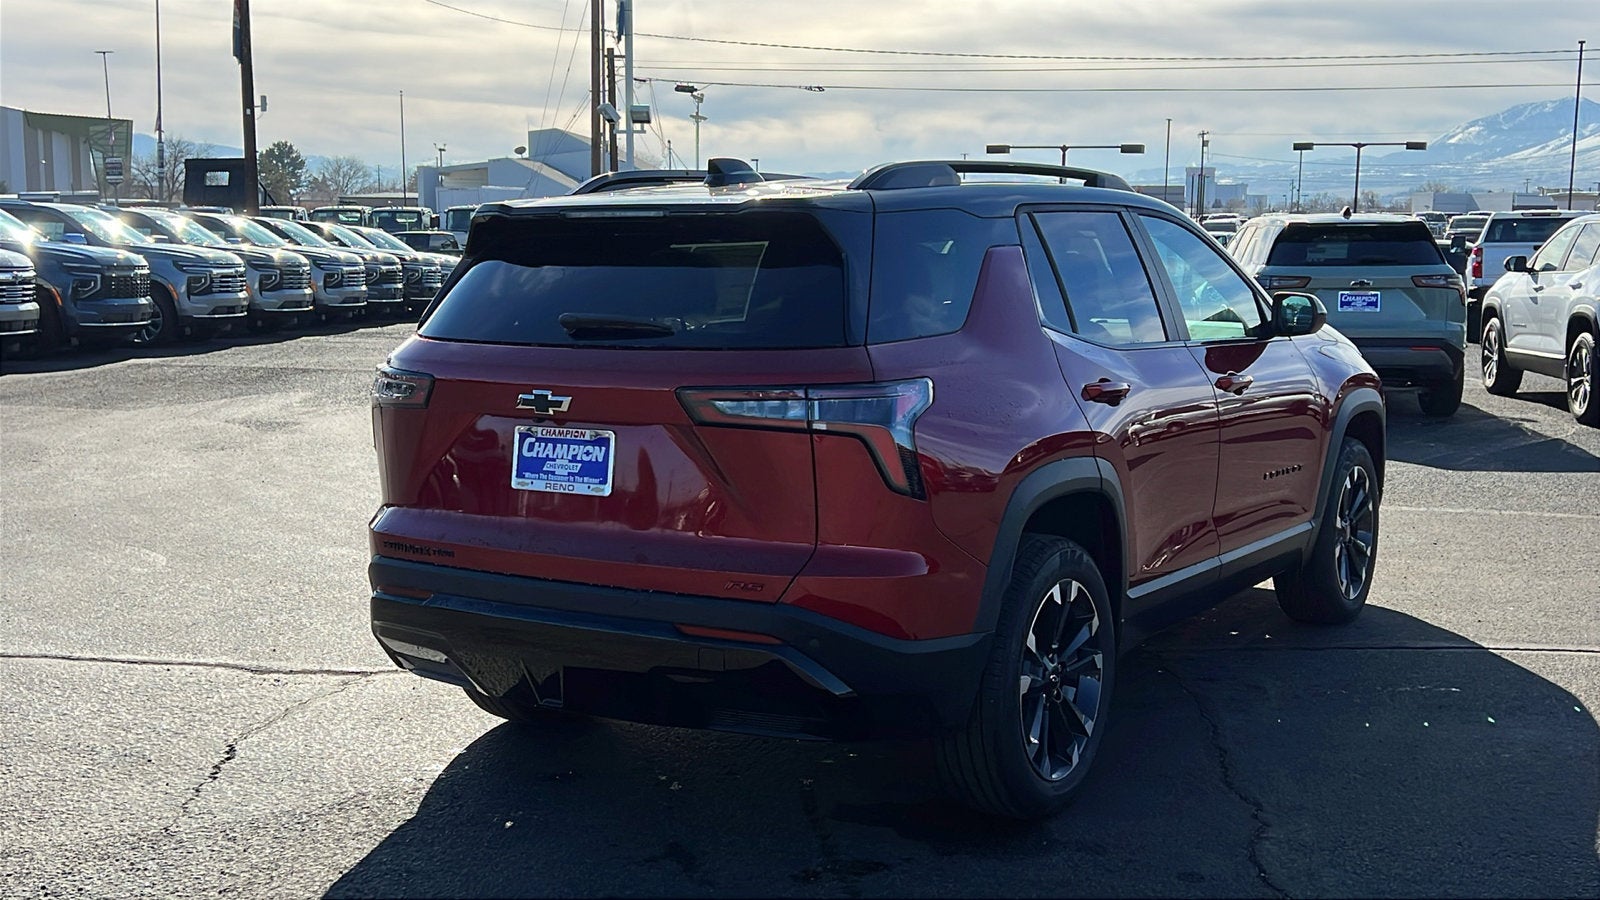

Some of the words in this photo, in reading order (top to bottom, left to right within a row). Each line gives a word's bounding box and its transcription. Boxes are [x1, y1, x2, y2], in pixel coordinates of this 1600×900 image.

[540, 428, 587, 438] CHAMPION
[522, 437, 606, 462] CHAMPION
[545, 462, 579, 471] CHEVROLET
[544, 482, 575, 492] RENO
